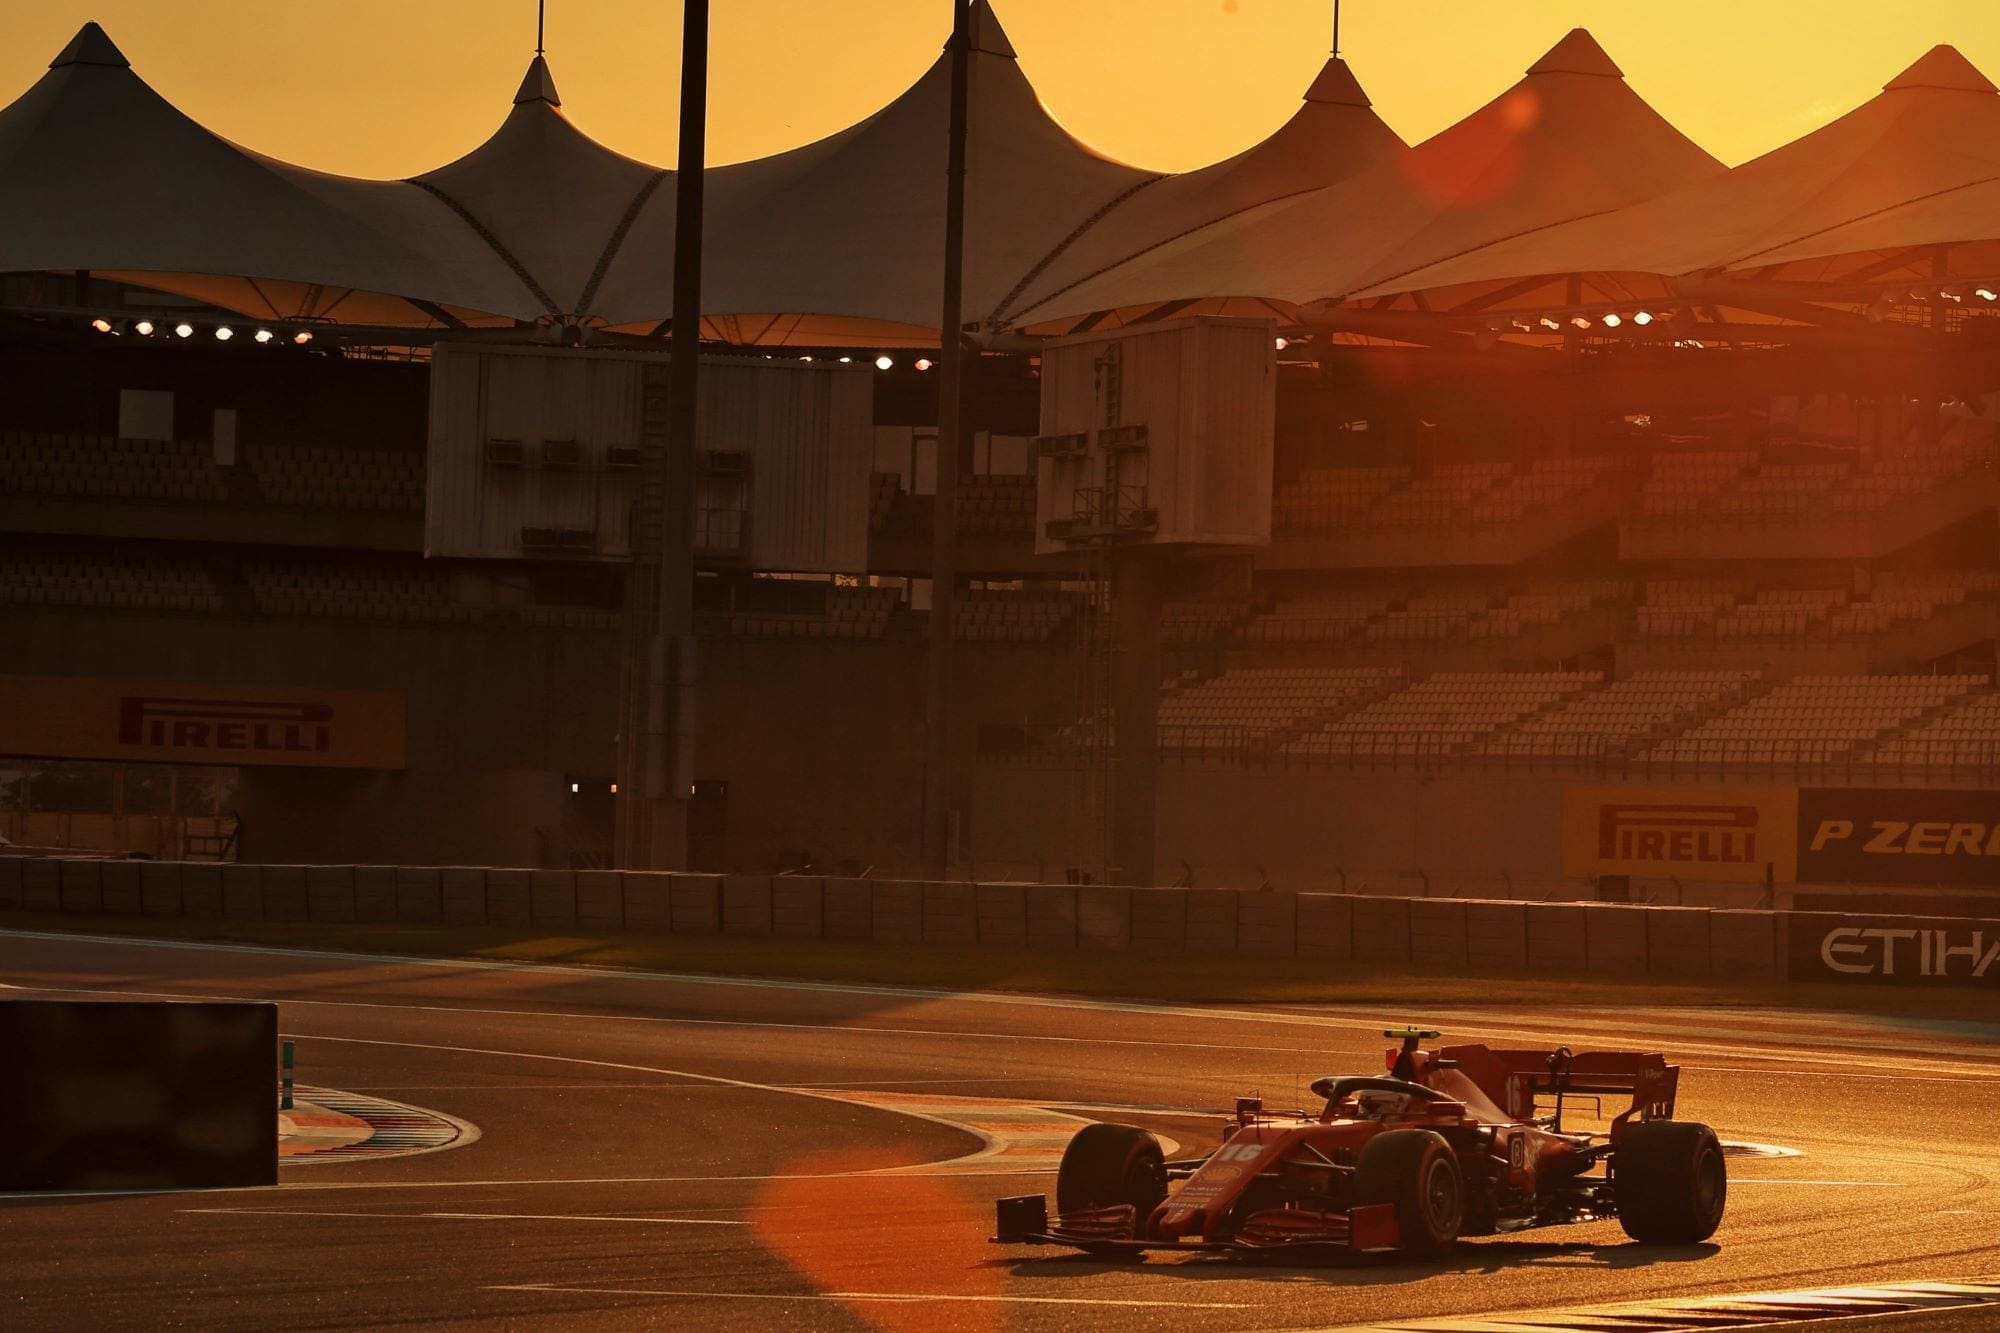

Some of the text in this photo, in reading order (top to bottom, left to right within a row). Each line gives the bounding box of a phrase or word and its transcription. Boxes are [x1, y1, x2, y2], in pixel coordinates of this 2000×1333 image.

[119, 697, 334, 751] PIRELLI
[1600, 805, 1759, 863] PIRELLI
[1810, 820, 1854, 852] P
[1218, 1144, 1264, 1162] 16
